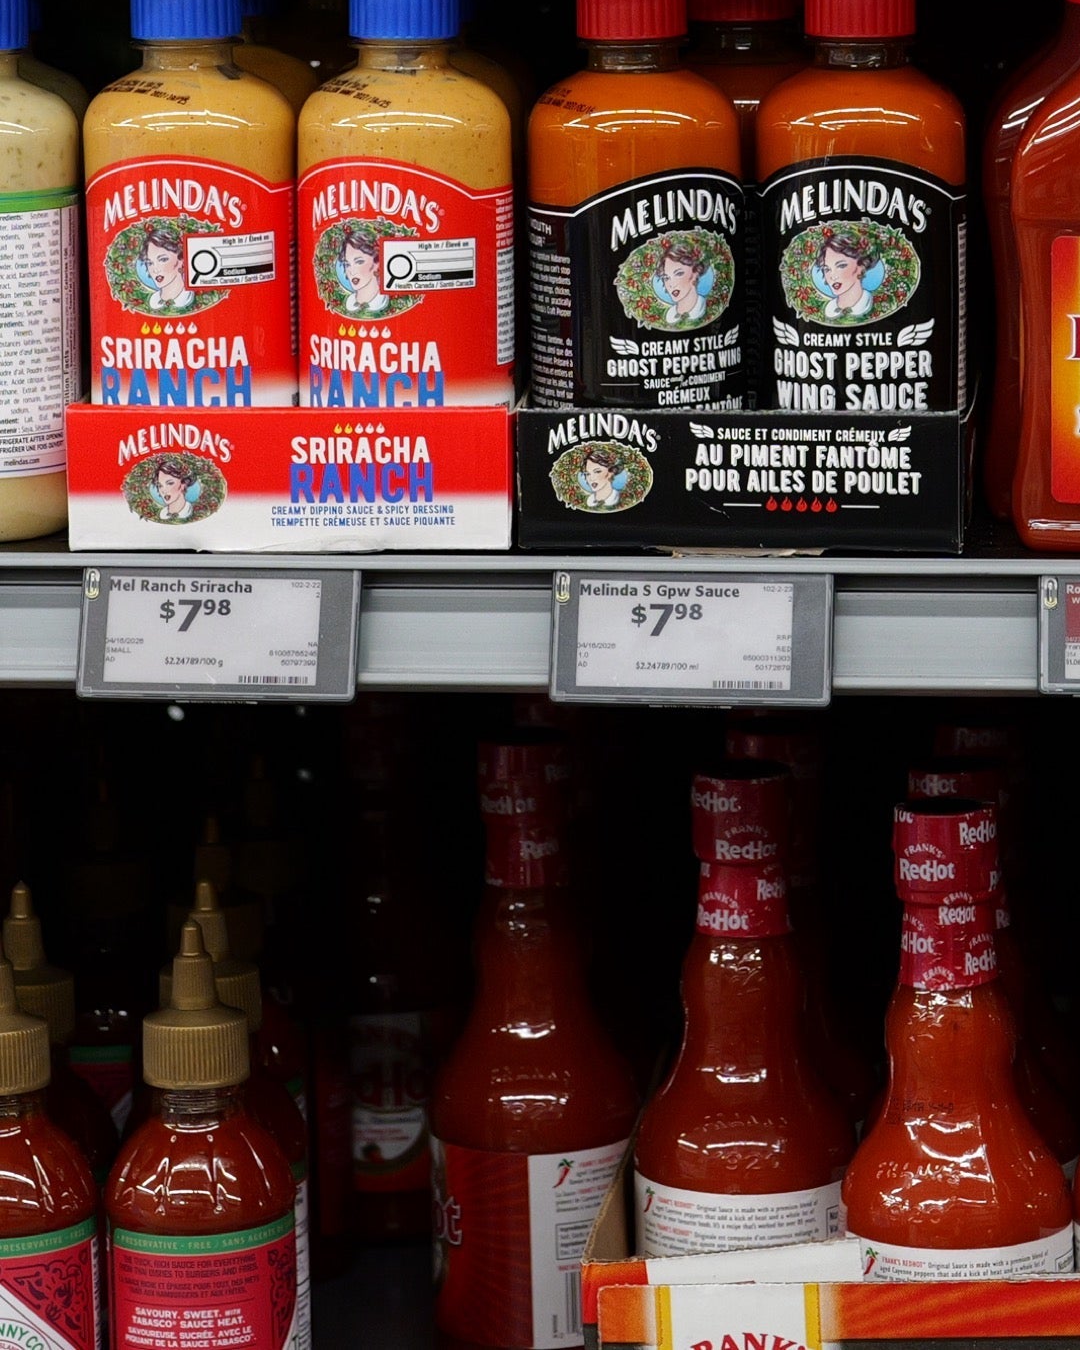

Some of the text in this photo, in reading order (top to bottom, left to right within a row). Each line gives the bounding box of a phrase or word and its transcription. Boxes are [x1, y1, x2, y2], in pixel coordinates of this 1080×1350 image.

[103, 178, 244, 232] MELINDA'S
[312, 180, 442, 233] MELINDA'S
[780, 179, 928, 235] MELINDA'S
[100, 336, 249, 369] SRIRACHA
[309, 335, 441, 373] SRIRACHA
[803, 332, 892, 347] CREAMY STYLE
[774, 348, 933, 380] GHOST PEPPER
[118, 423, 231, 466] MELINDA'S
[547, 413, 657, 454] MELINDA'S
[290, 437, 430, 464] SRIRACHA
[695, 440, 912, 470] AU PIMENT FANTÔME
[289, 463, 434, 503] RANCH
[686, 469, 921, 494] POUR AILES DE POULET
[271, 506, 307, 515] CREAMY
[310, 506, 343, 515] DIPPING
[346, 506, 374, 514] SAUCE
[385, 506, 409, 514] SPICY
[412, 506, 454, 514] DRESSING
[271, 517, 320, 527] TREMPETTE
[370, 517, 381, 526] ET
[384, 517, 411, 526] SAUCE
[414, 517, 455, 526] PIQUANTE
[110, 580, 252, 593] Mel Ranch Sriracha
[580, 585, 740, 600] Melinda S Gpw Sauce
